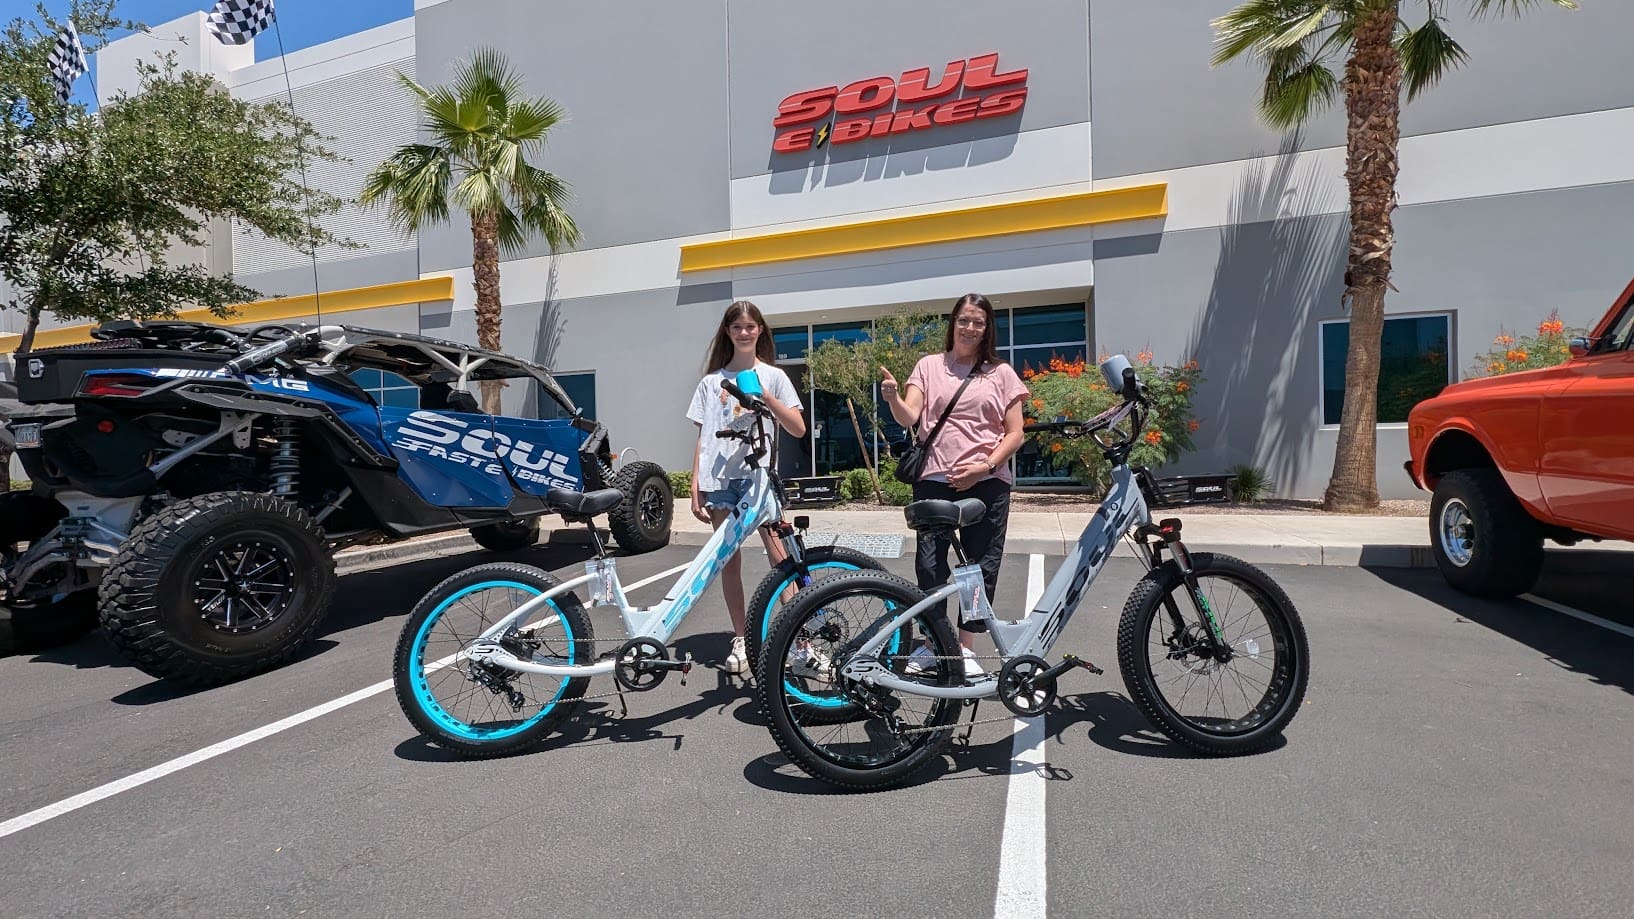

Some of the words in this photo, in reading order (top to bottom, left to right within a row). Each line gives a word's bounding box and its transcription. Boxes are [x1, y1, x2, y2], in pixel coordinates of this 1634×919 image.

[773, 52, 1029, 128] SOUL
[391, 437, 488, 468] FAST
[397, 410, 579, 483] SOUL
[1040, 497, 1139, 650] SOUL
